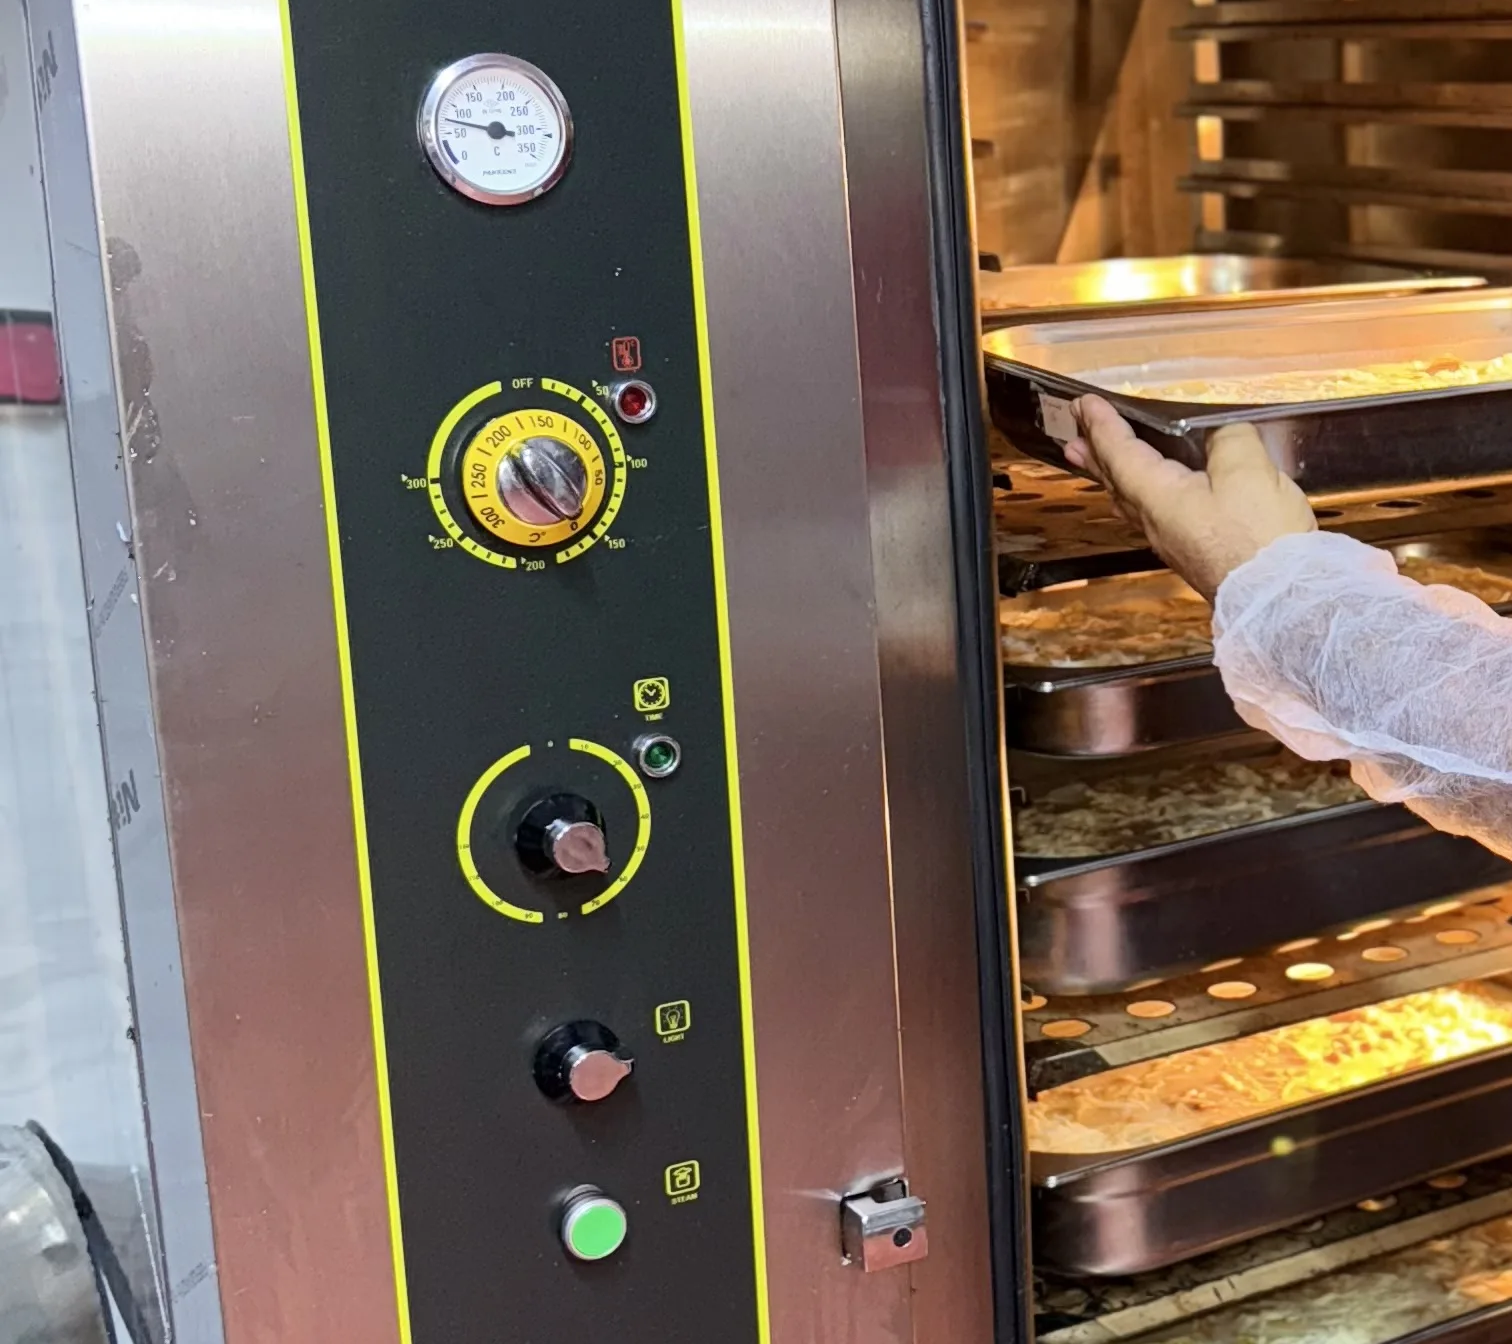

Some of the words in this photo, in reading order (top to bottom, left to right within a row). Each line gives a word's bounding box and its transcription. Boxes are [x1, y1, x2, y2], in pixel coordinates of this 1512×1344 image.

[466, 92, 483, 102] 150
[496, 91, 515, 101] 200
[455, 109, 472, 119] 100
[510, 107, 529, 117] 250
[454, 128, 467, 138] 50
[516, 125, 535, 135] 300
[517, 143, 536, 153] 350
[461, 150, 468, 160] 0
[512, 378, 534, 389] OFF
[596, 385, 609, 396] 50
[529, 415, 554, 428] 150
[486, 425, 512, 448] 200
[573, 429, 592, 451] 100
[630, 458, 648, 468] 100
[471, 463, 487, 488] 250
[594, 469, 603, 486] 50
[406, 477, 427, 489] 300
[480, 507, 505, 529] 300
[570, 522, 578, 531] 0
[433, 538, 453, 549] 250
[608, 538, 626, 549] 150
[526, 560, 545, 571] 200
